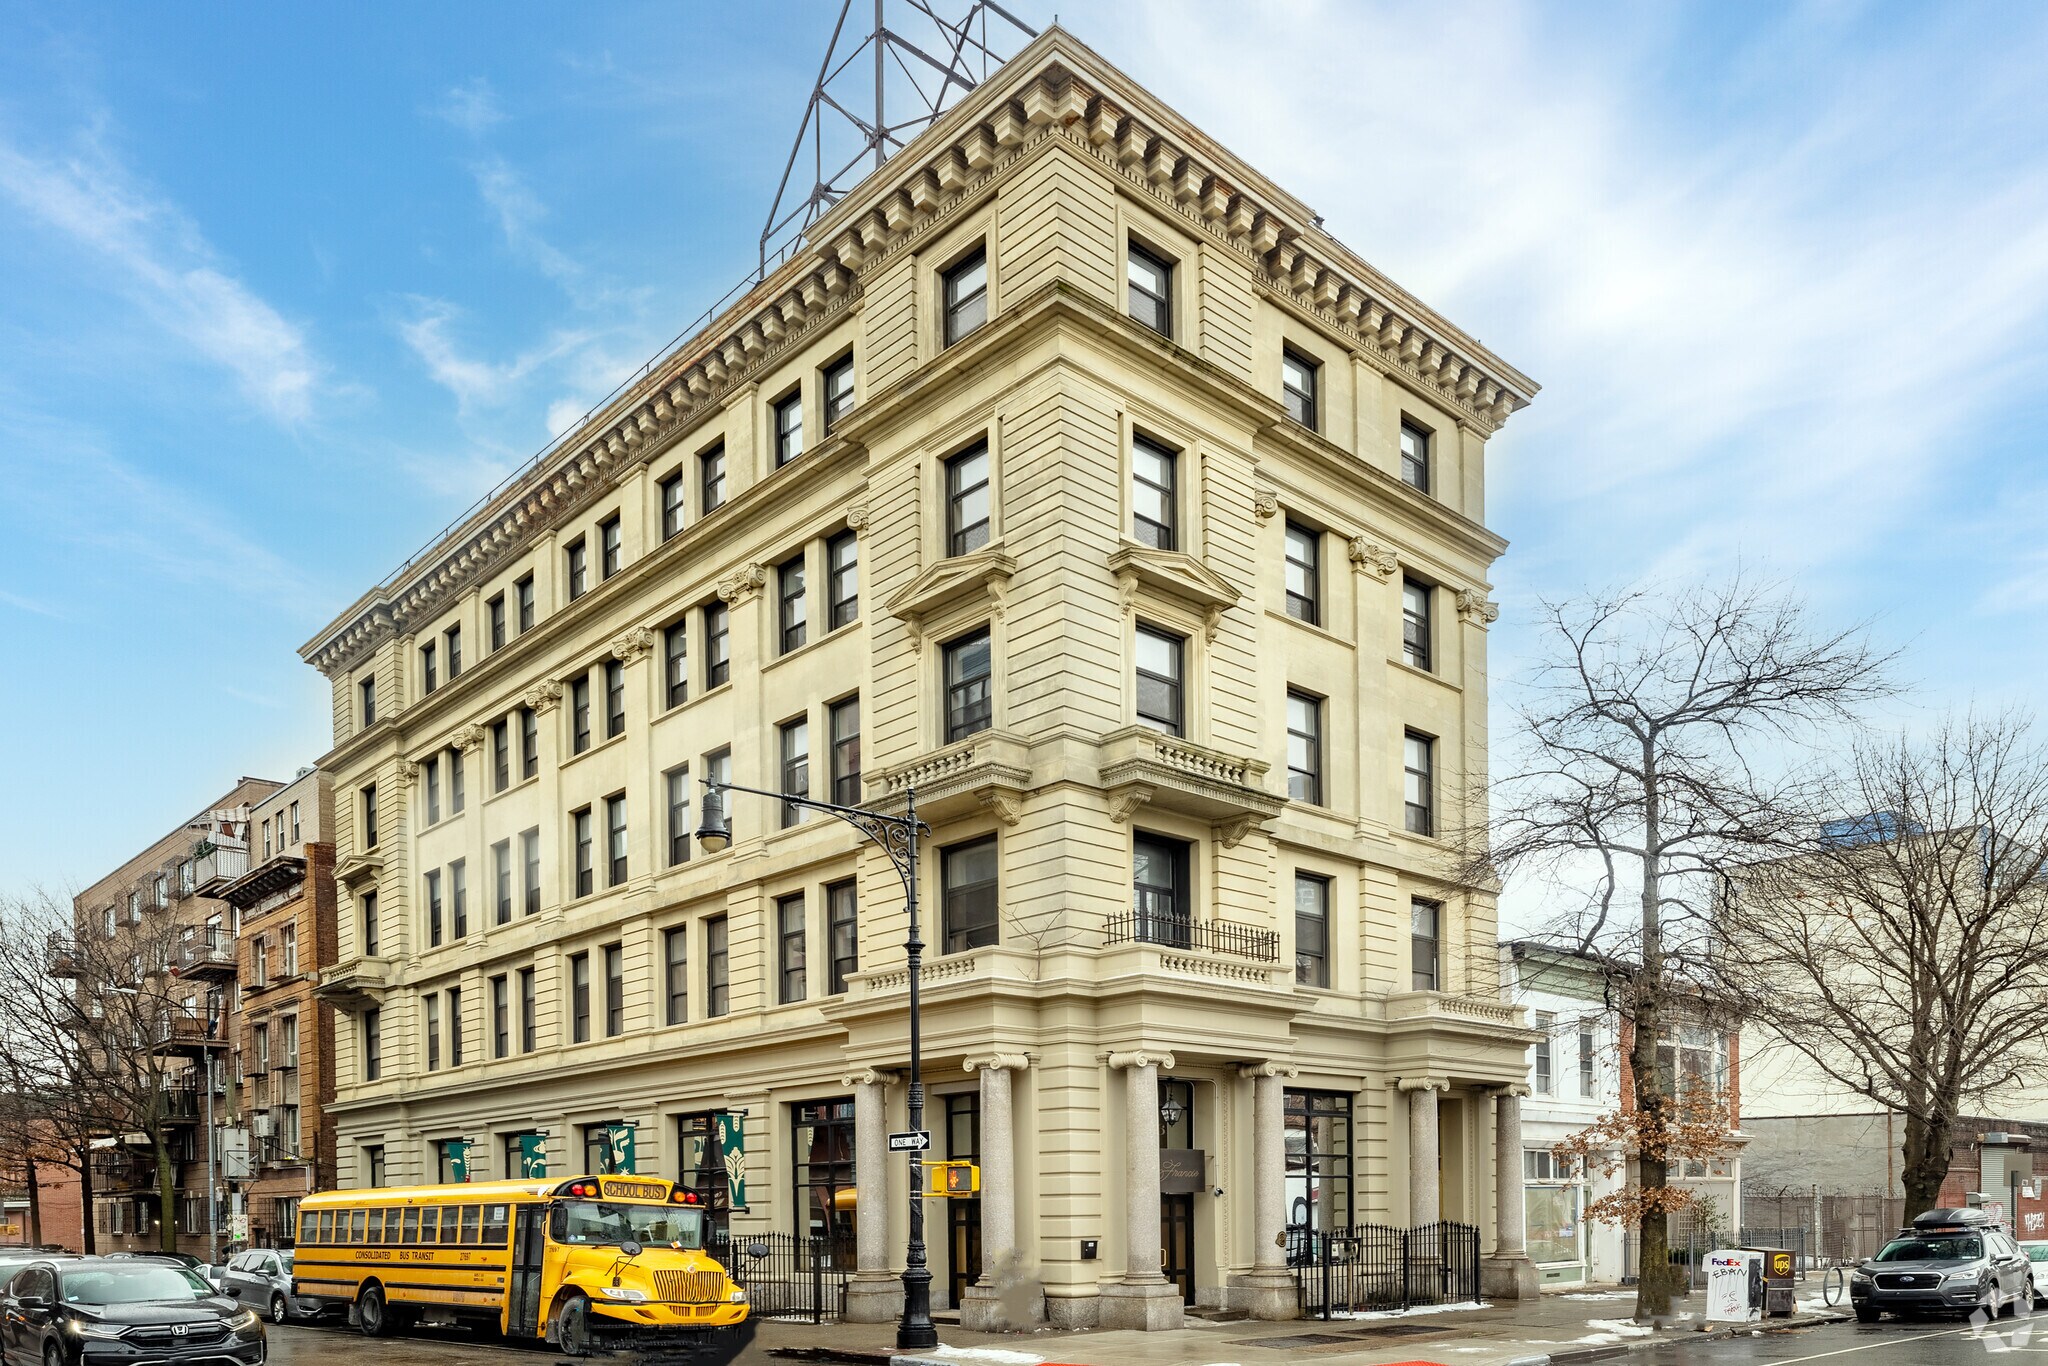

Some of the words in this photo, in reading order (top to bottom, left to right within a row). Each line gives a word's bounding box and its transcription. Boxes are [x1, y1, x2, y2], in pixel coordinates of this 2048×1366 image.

[911, 1137, 923, 1145] WAY
[605, 1183, 640, 1197] SCHOOL
[642, 1185, 661, 1199] BUS
[355, 1251, 391, 1260] CONSOLIDATED
[400, 1251, 410, 1260] BUS
[412, 1251, 435, 1260] TRANSIT
[1711, 1258, 1741, 1267] FedEx
[1775, 1260, 1789, 1272] ups
